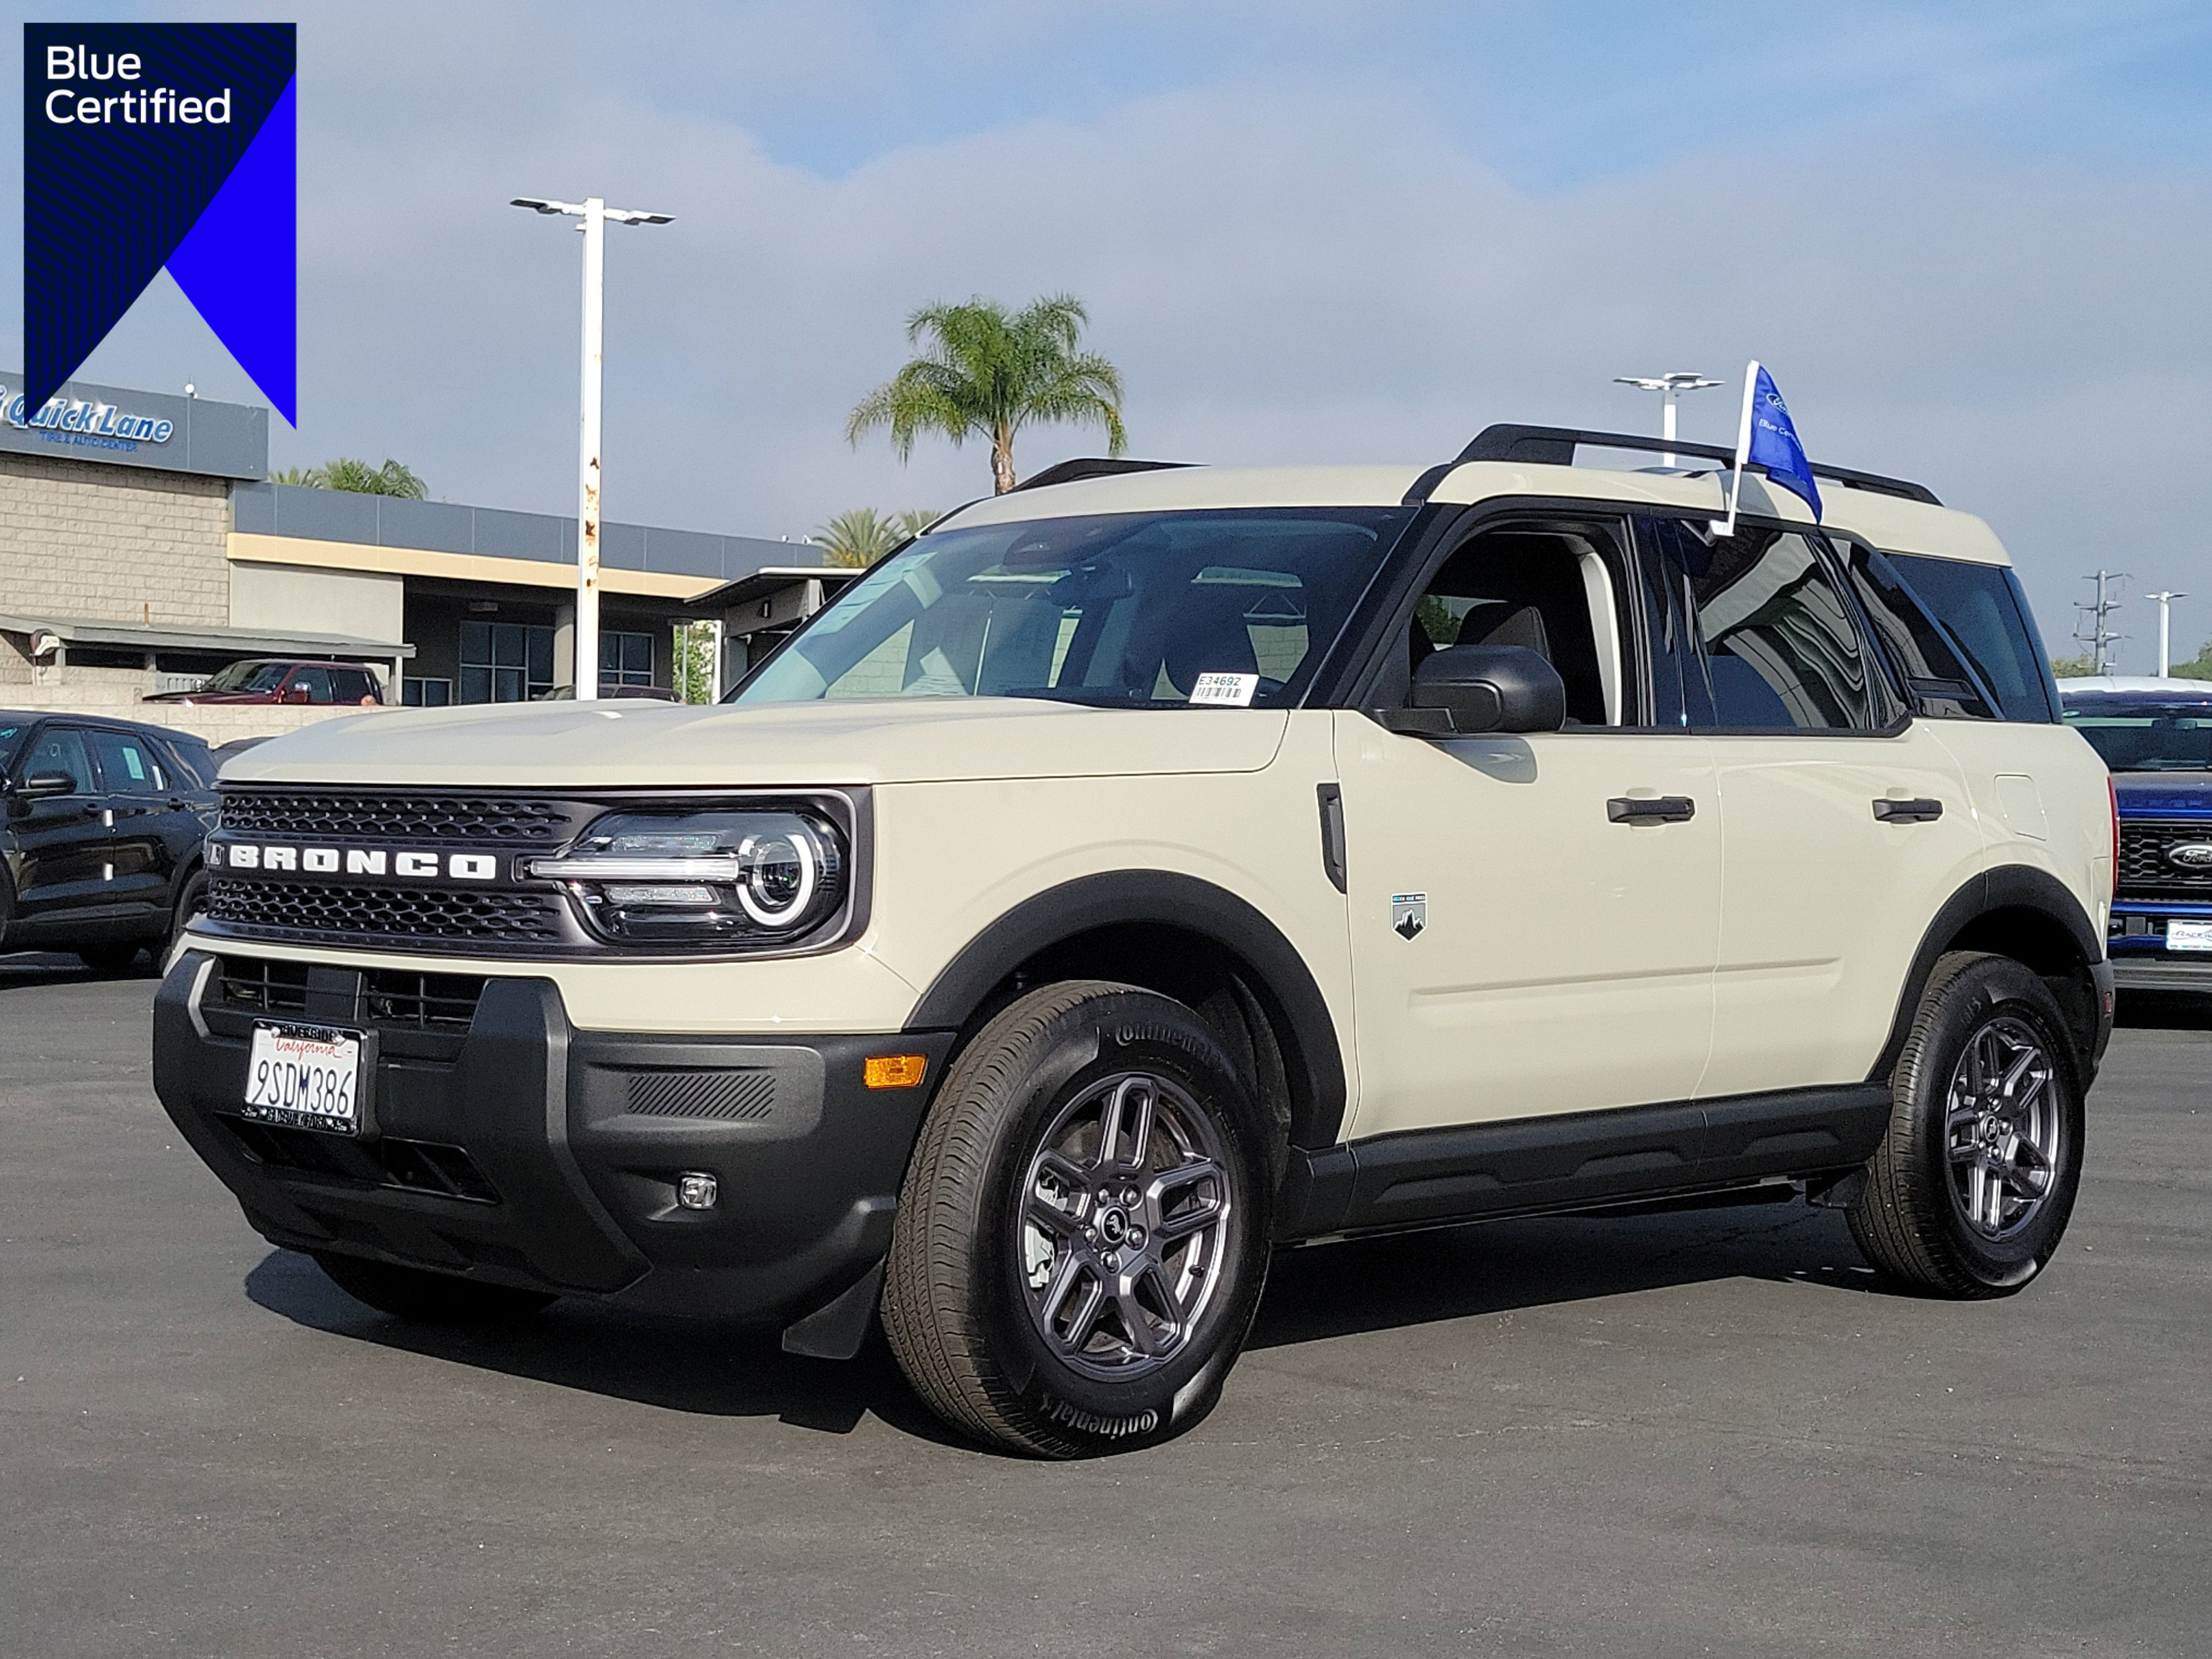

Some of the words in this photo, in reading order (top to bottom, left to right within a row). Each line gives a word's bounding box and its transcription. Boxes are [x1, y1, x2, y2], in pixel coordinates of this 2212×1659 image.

[99, 405, 173, 443] Lane
[1198, 676, 1242, 686] E34692
[229, 844, 496, 880] BRONCO
[275, 1037, 342, 1062] California
[252, 1059, 353, 1115] 9SDM386
[1050, 1401, 1159, 1440] Continental
